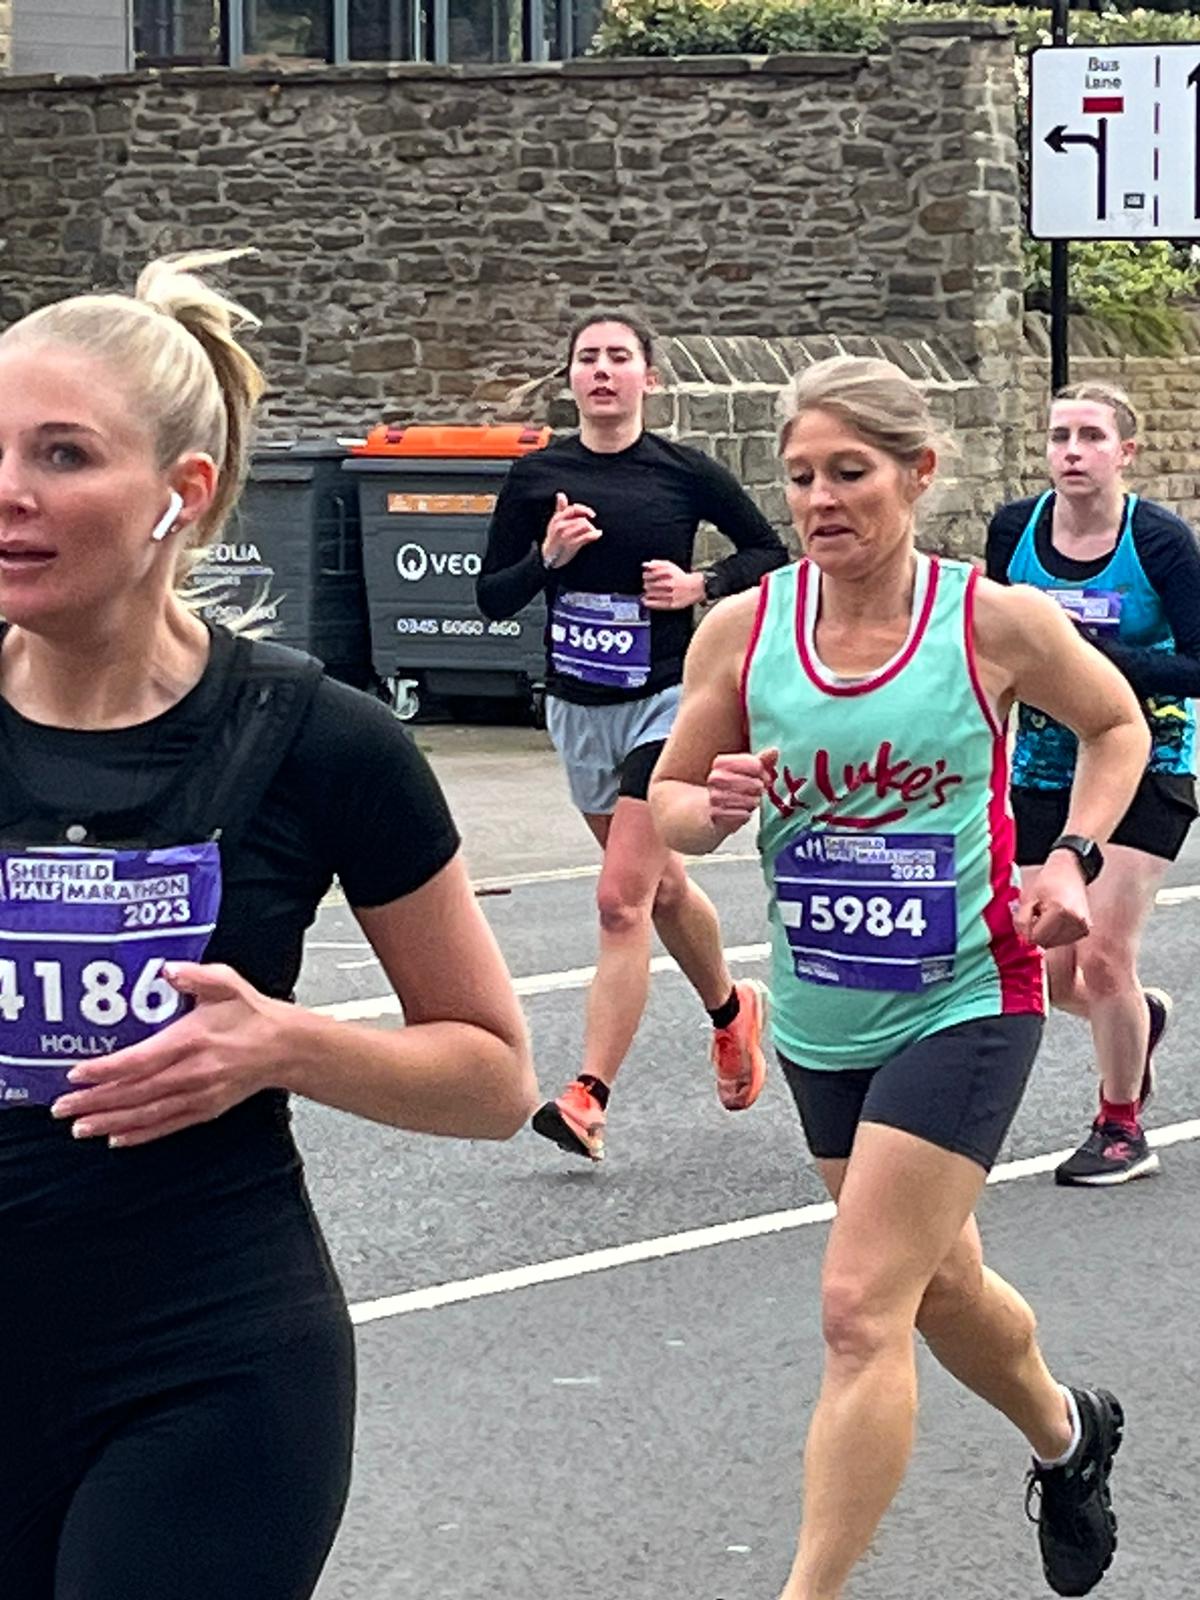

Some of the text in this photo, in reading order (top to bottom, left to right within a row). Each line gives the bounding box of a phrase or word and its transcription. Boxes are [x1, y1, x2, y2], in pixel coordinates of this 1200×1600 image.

[1087, 56, 1120, 72] Bus
[1084, 74, 1122, 90] Lane
[207, 543, 262, 562] EOLIA
[430, 552, 482, 575] VEO
[569, 624, 635, 654] 5699
[814, 740, 963, 809] Luke's
[9, 862, 111, 881] SHEFFIELD
[889, 864, 936, 880] 2023
[9, 876, 187, 902] HALF MARATHON
[122, 898, 191, 928] 2023
[809, 894, 927, 938] 5984
[0, 956, 179, 1027] 4186
[40, 1034, 118, 1053] HOLLY
